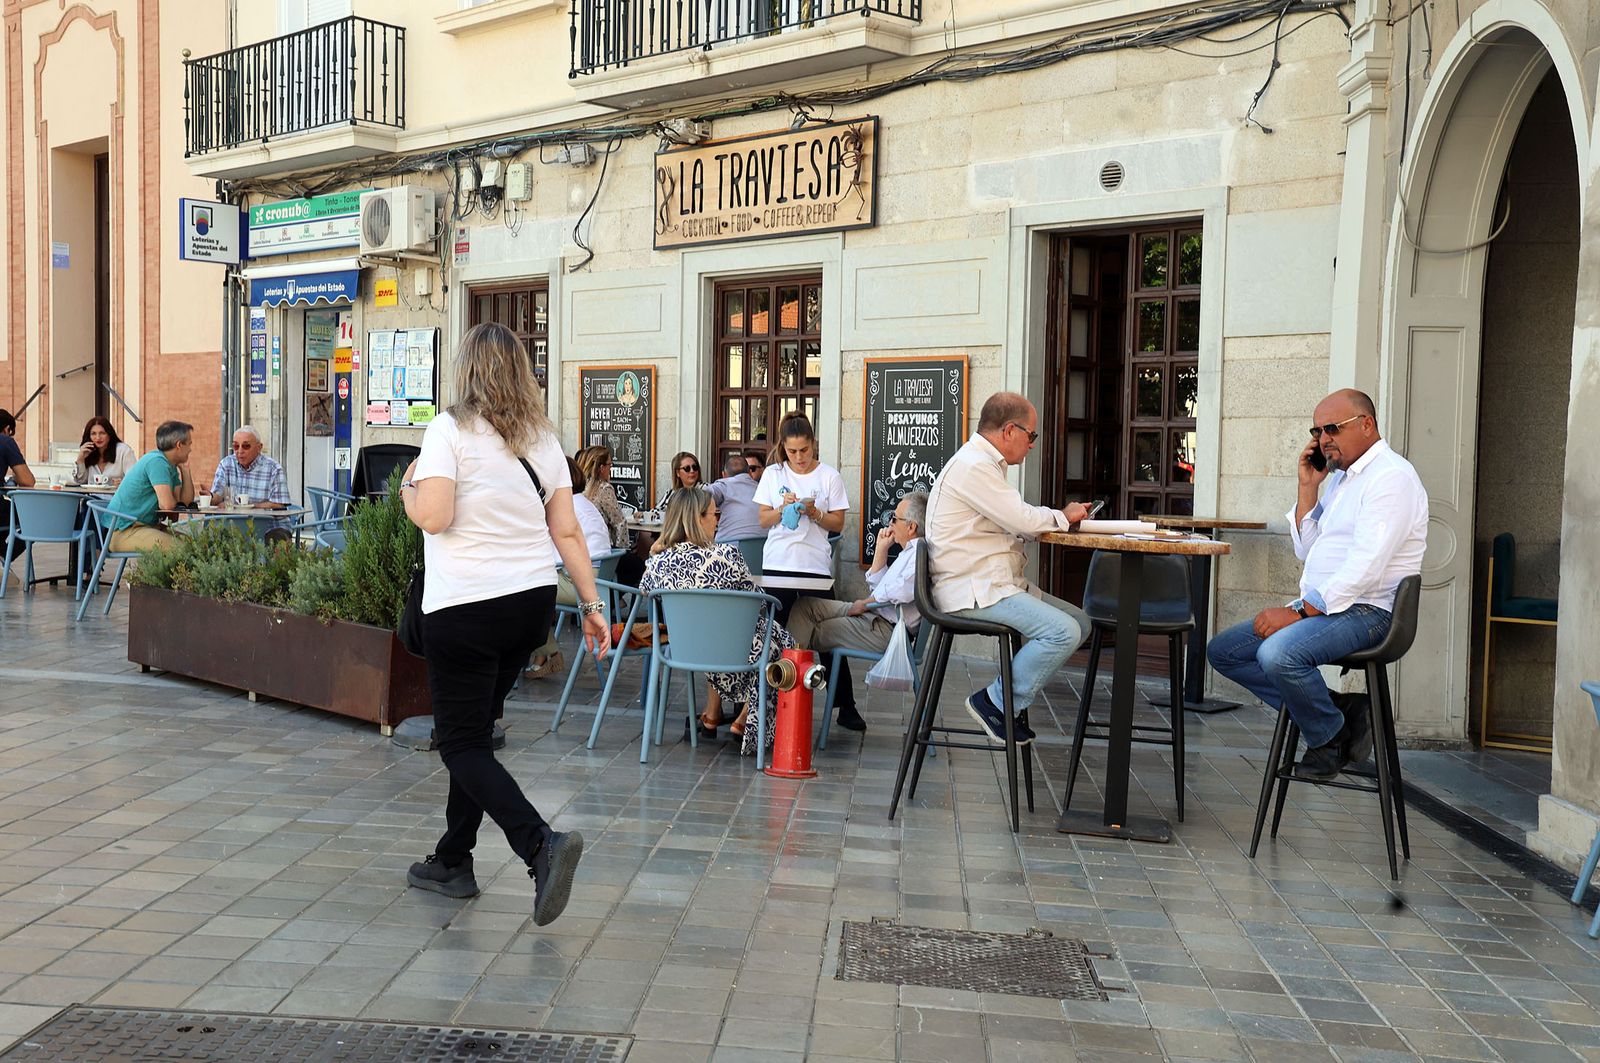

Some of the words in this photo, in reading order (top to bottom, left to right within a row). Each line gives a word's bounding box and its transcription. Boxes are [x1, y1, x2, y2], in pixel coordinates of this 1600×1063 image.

[680, 158, 703, 216] LA
[715, 136, 841, 211] TRAVIESA
[266, 201, 311, 220] cronub@
[682, 216, 723, 238] COCKTAIL
[731, 212, 752, 232] FOOD
[296, 286, 318, 295] Apuestas
[318, 284, 327, 292] del
[328, 282, 345, 292] Estado
[894, 379, 901, 396] LA
[904, 379, 933, 396] TRAVIESA
[590, 407, 610, 419] NEVER
[614, 408, 632, 416] LOVE
[888, 413, 938, 425] DESAYUNOS
[590, 420, 602, 430] GIVE
[604, 420, 610, 430] UP
[887, 426, 939, 447] ALMUERZOS
[908, 449, 916, 459] &
[610, 465, 641, 479] TELERÍA
[888, 452, 938, 486] Cenas
